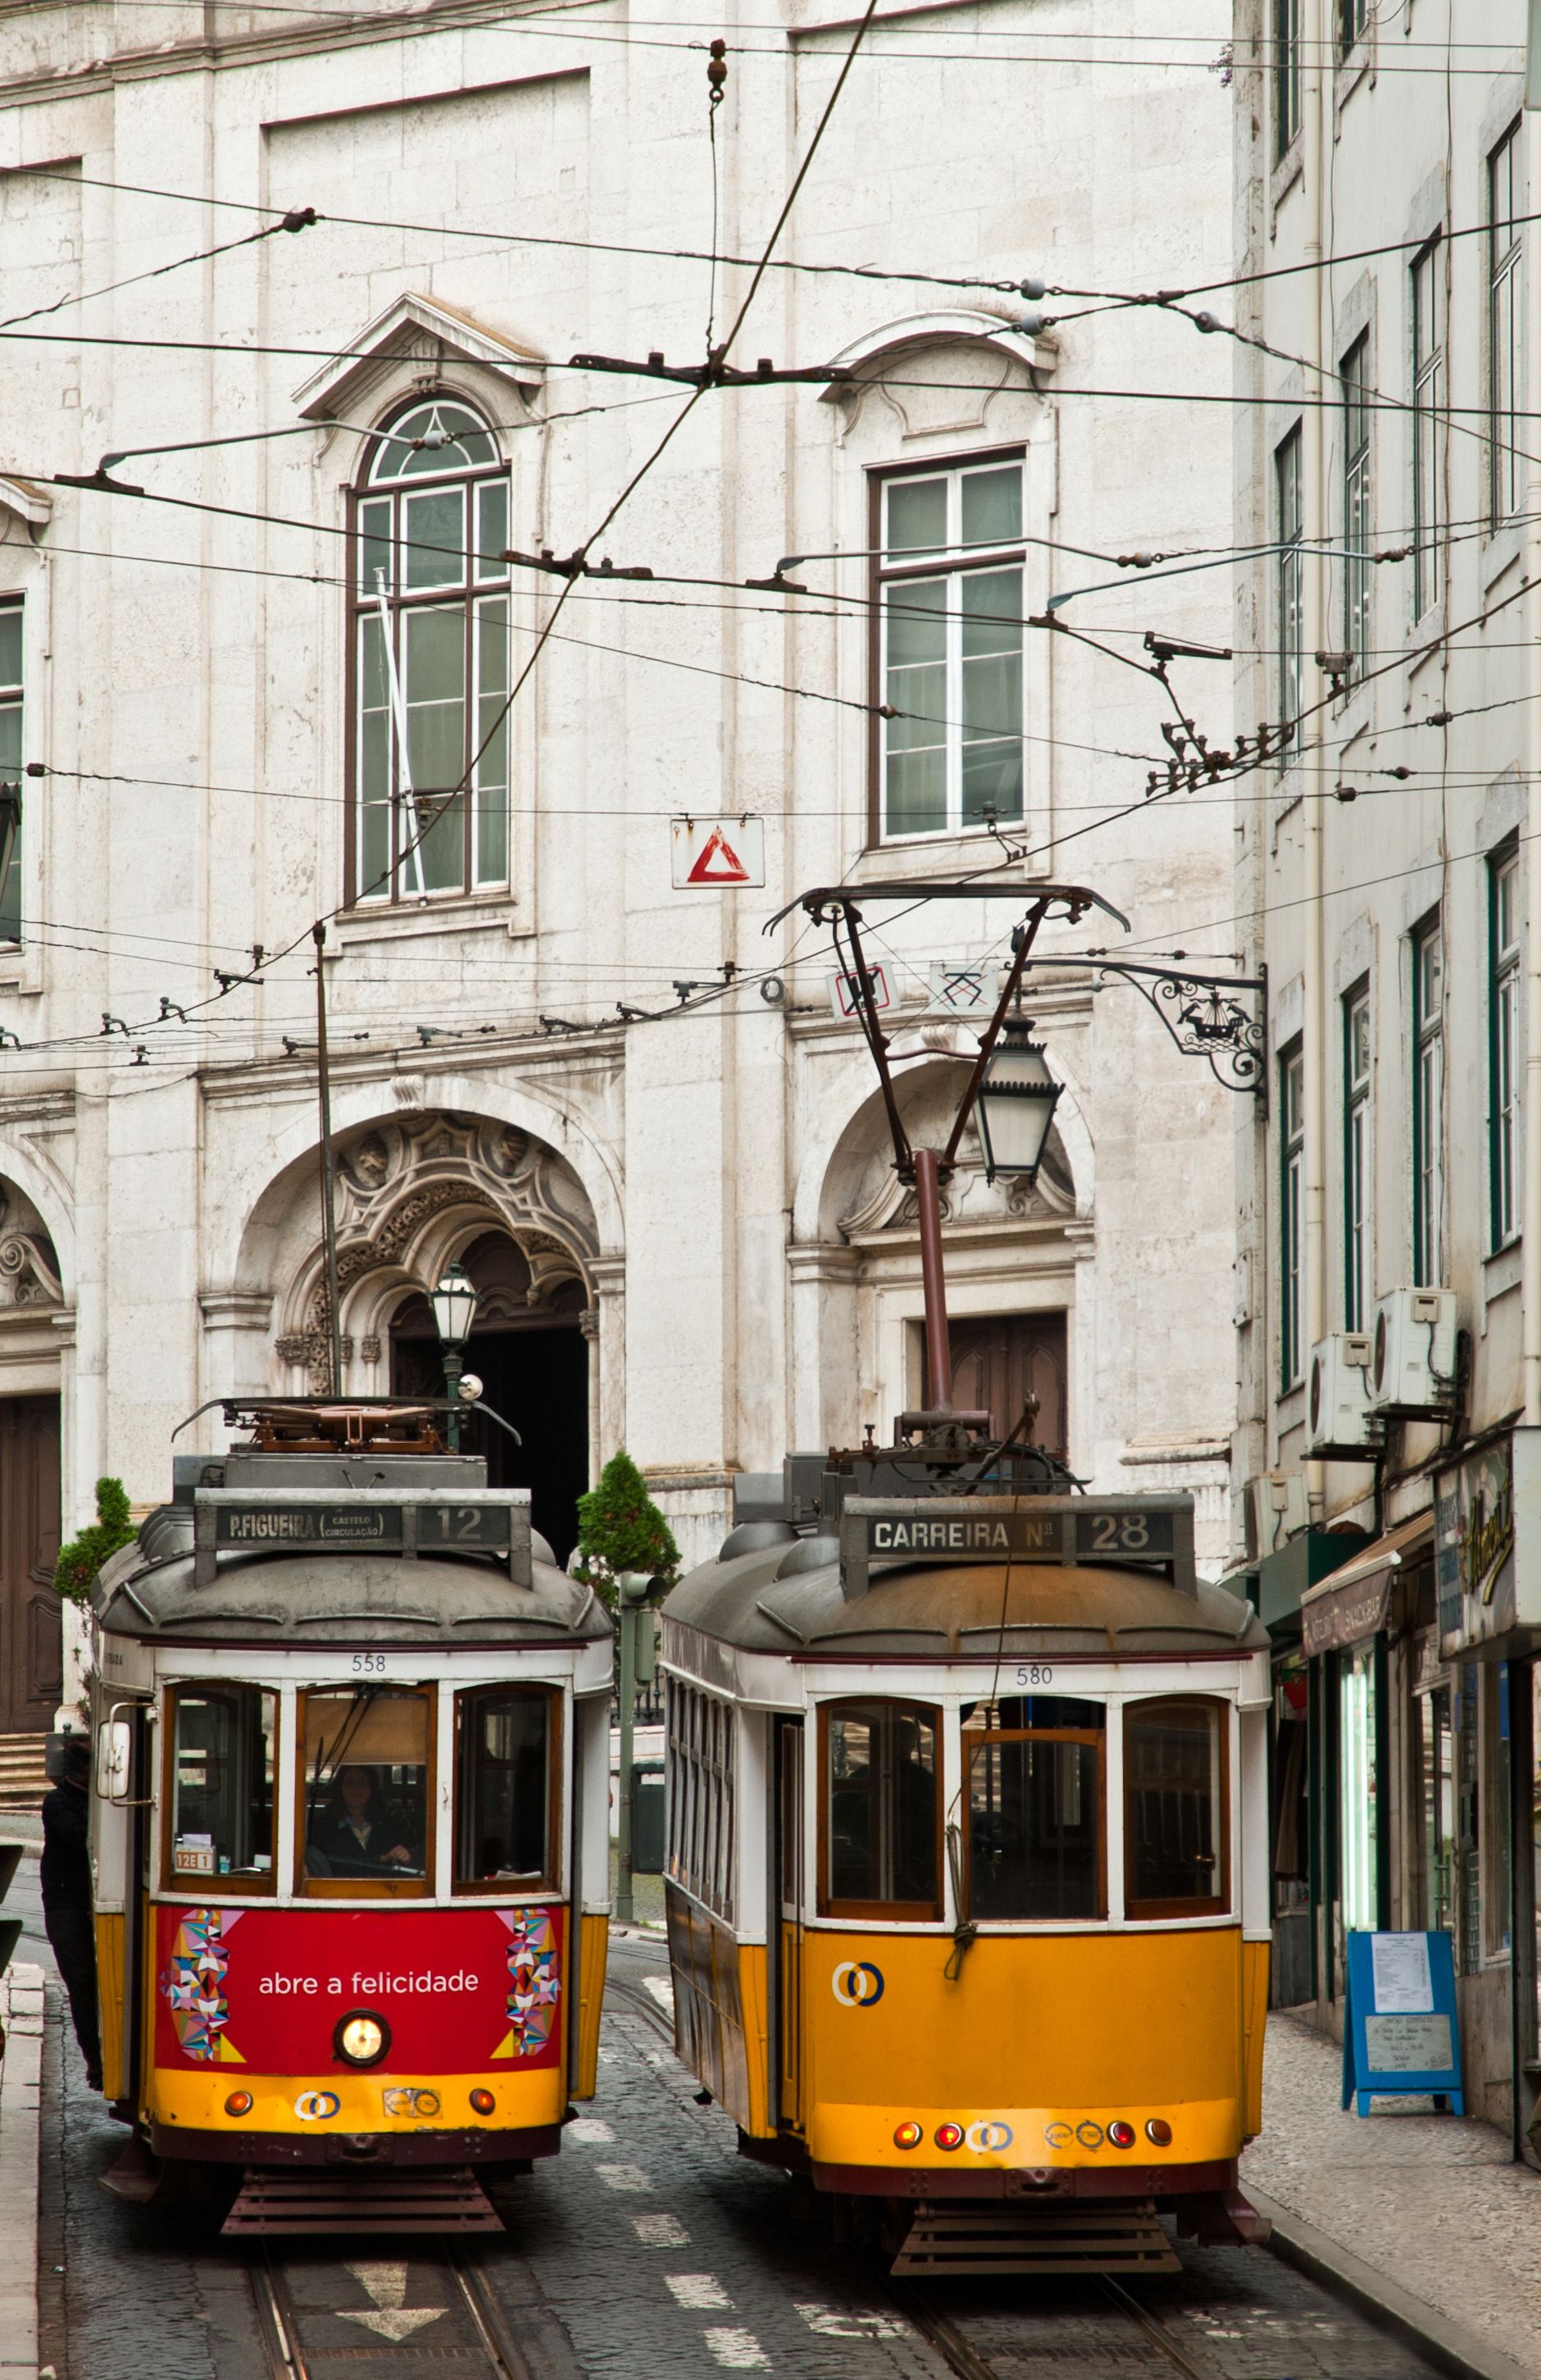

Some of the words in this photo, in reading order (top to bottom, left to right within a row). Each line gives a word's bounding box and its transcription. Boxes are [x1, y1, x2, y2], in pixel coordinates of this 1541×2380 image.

[332, 1515, 370, 1526] CASTELO
[437, 1508, 482, 1540] 12
[325, 1527, 378, 1537] CIRCULAÇÃO
[875, 1522, 1009, 1548] CARREIRA
[1091, 1514, 1149, 1550] 28
[352, 1654, 385, 1672] 558
[1016, 1667, 1052, 1686] 580
[177, 1854, 196, 1868] 12E
[259, 1972, 318, 1995] abre
[327, 1977, 342, 1995] a
[351, 1969, 479, 1994] felicidade
